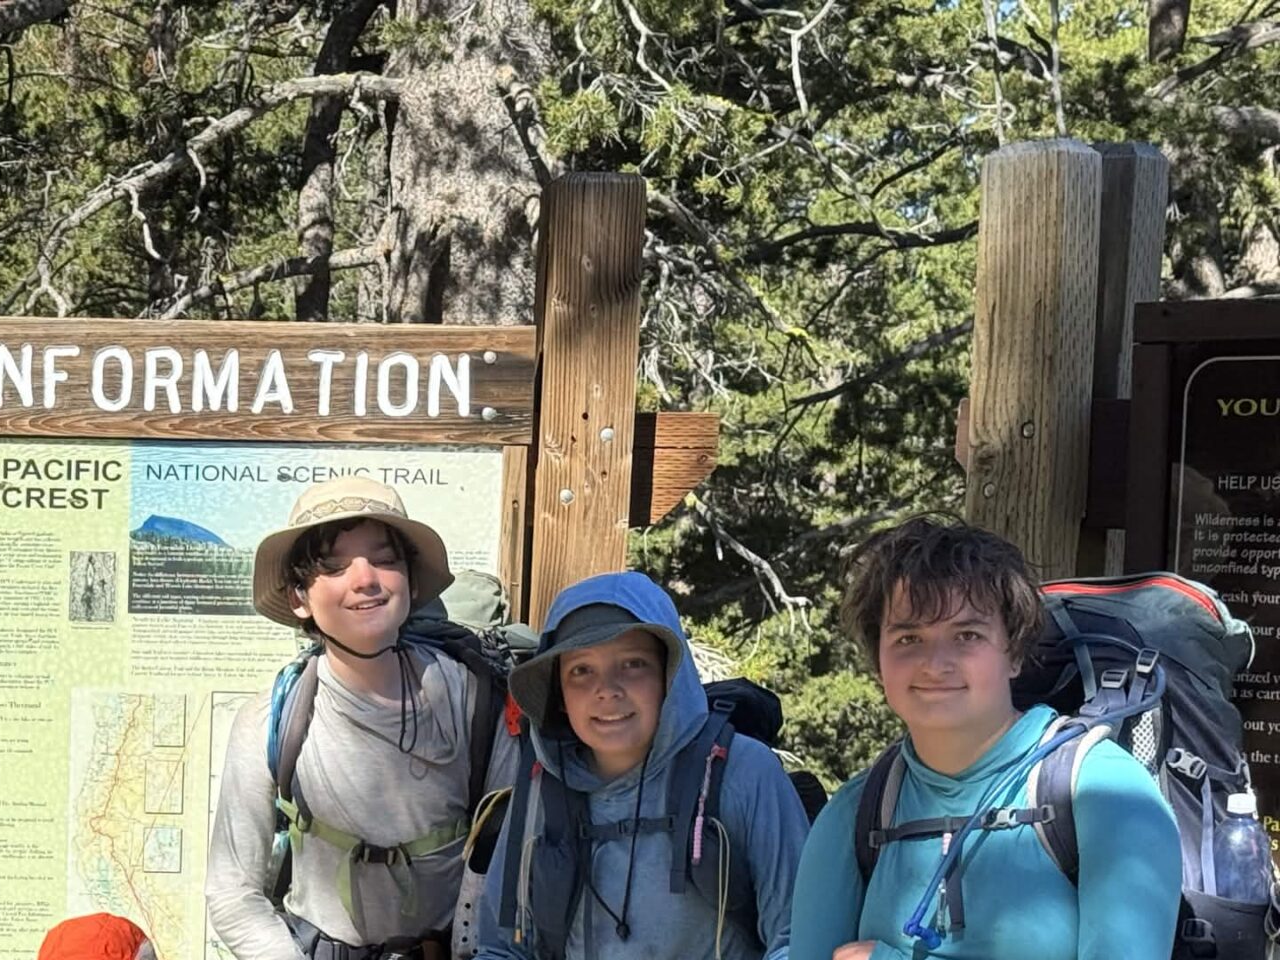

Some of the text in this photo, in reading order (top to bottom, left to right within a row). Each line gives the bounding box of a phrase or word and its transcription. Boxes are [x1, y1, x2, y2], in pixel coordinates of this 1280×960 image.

[2, 458, 122, 482] PACIFIC
[146, 464, 269, 482] NATIONAL
[378, 467, 449, 485] TRAIL
[1218, 475, 1257, 490] HELP
[2, 487, 110, 509] CREST
[1195, 512, 1260, 527] Wilderness
[1263, 513, 1274, 527] is
[1194, 529, 1205, 541] It
[1208, 529, 1219, 541] is
[1192, 545, 1237, 561] provide
[1192, 561, 1258, 575] unconfined
[1250, 750, 1271, 763] the
